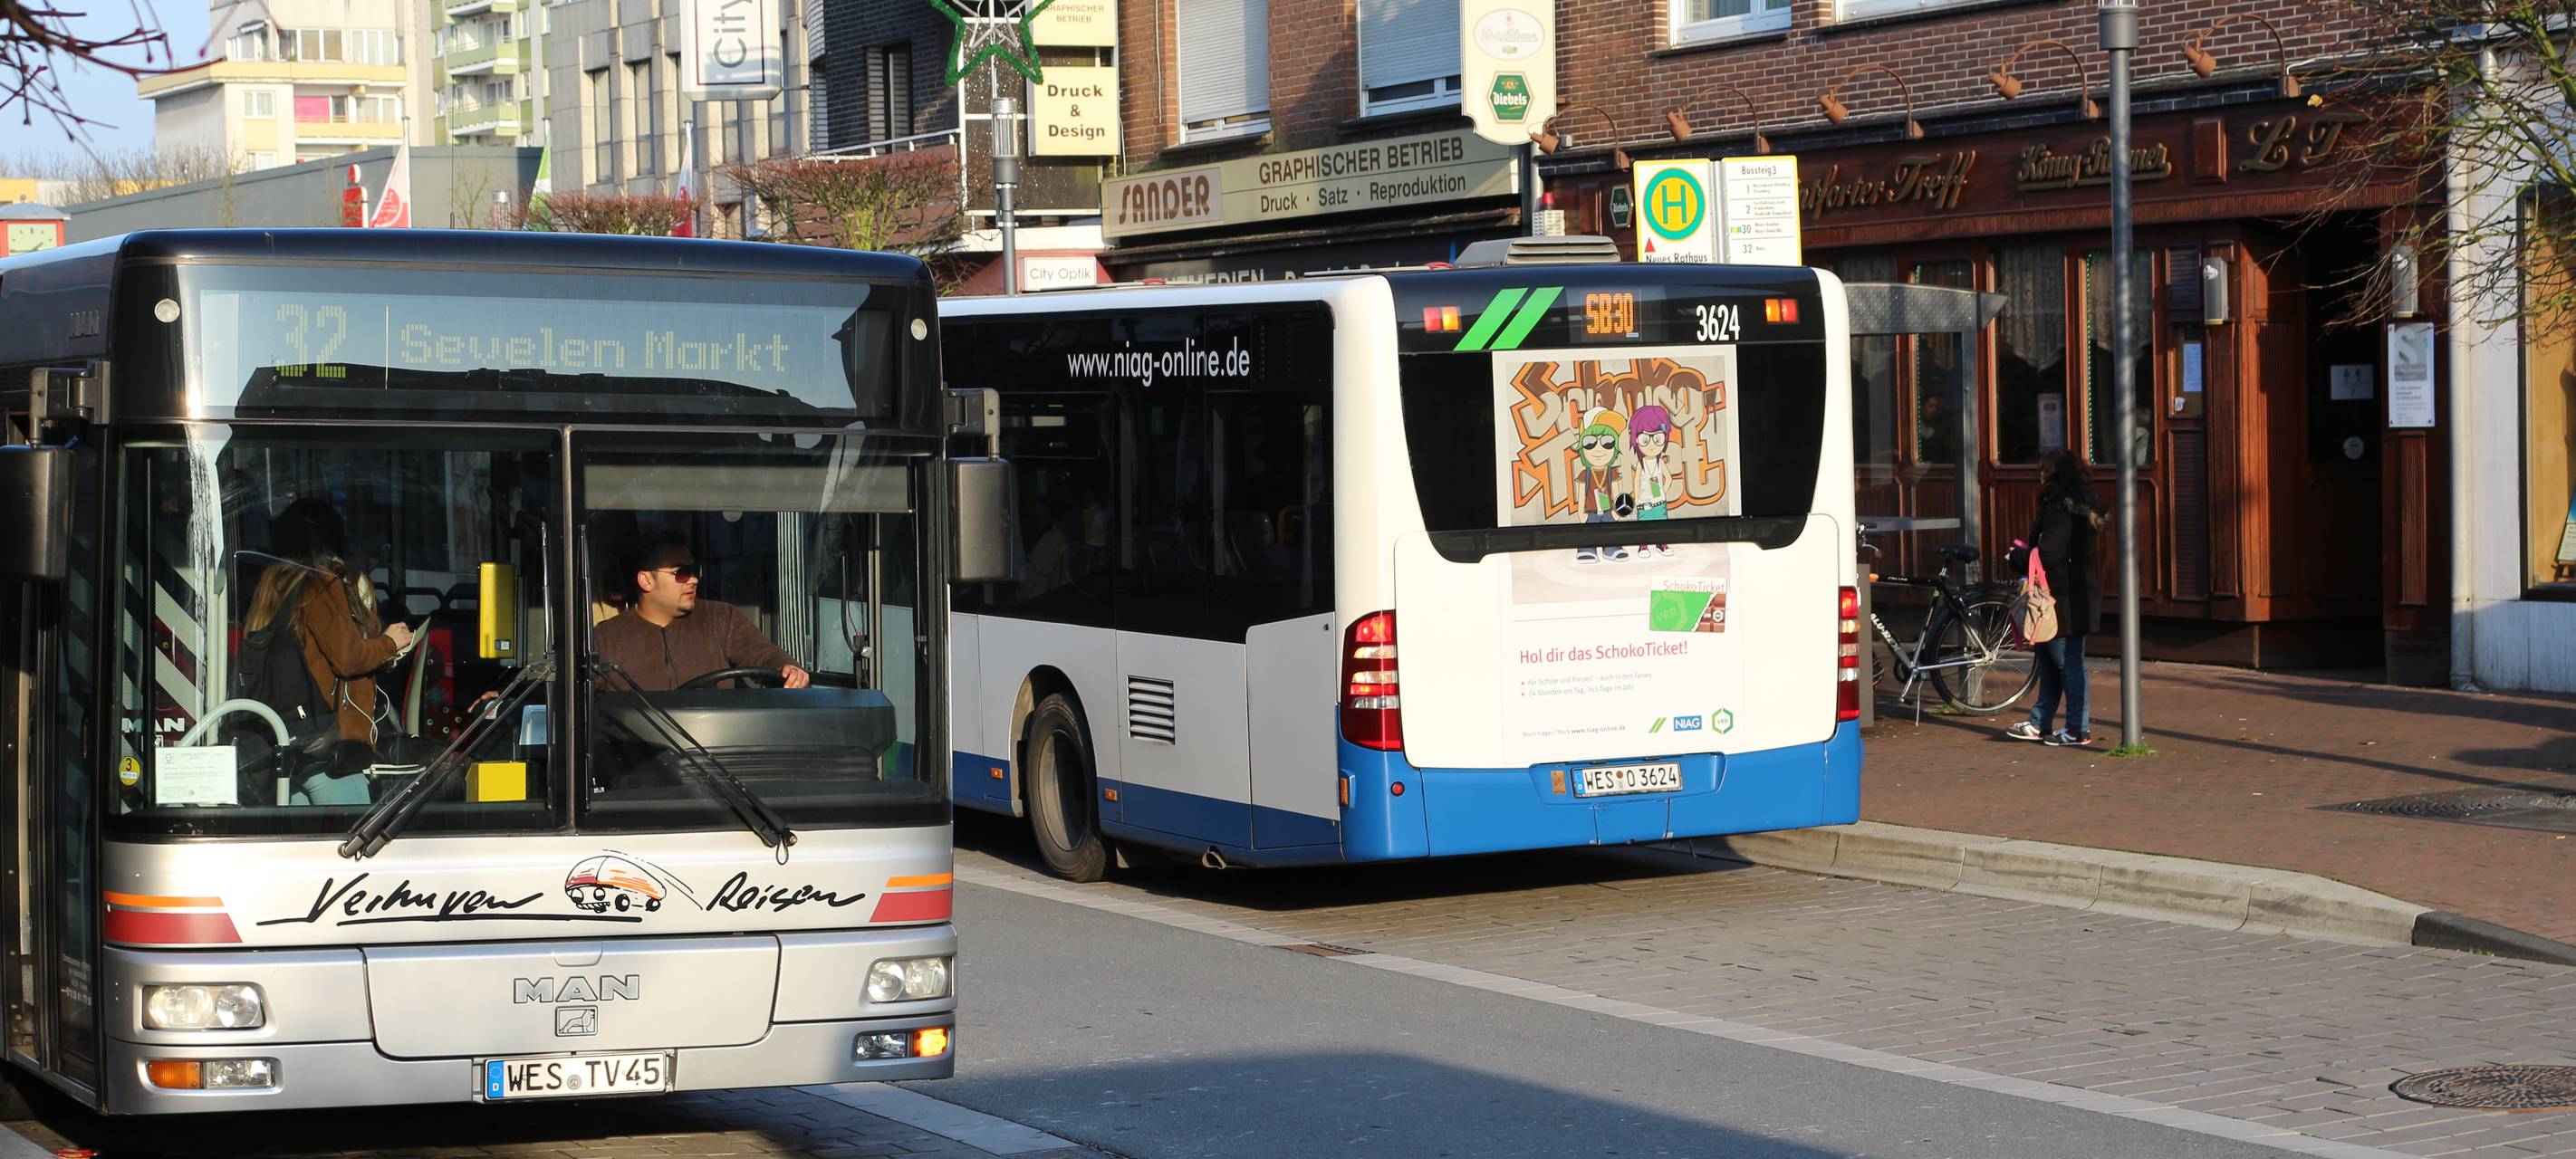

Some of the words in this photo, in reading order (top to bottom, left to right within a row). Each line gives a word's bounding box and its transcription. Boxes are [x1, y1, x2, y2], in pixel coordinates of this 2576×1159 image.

[1056, 14, 1092, 23] BETRIEB
[1047, 84, 1103, 97] Druck
[1493, 91, 1527, 105] Diebels
[1070, 104, 1081, 117] &
[1049, 125, 1105, 140] Design
[1259, 147, 1380, 185] GRAPHISCHER
[1388, 137, 1464, 168] BETRIEB
[1741, 166, 1772, 176] Bussteig
[1772, 166, 1777, 175] 3
[1888, 150, 1976, 209] Treff
[1119, 175, 1210, 225] SANDER
[1261, 192, 1298, 213] Druck
[1318, 187, 1348, 206] Satz
[1370, 175, 1466, 201] Reproduktion
[1661, 185, 1687, 224] H
[1646, 254, 1671, 263] Neues
[1674, 252, 1707, 263] Rathaus
[1743, 244, 1753, 254] 32
[1029, 267, 1055, 283] City
[1058, 267, 1091, 282] Optik
[1586, 292, 1634, 334] SB30
[1696, 304, 1740, 341] 3624
[276, 304, 348, 378] 32
[400, 323, 625, 369] Sevelen
[646, 330, 789, 373] Markt
[1067, 336, 1250, 387] www.niag-online.de
[1663, 580, 1725, 594] SchokoTicket
[1519, 647, 1543, 664] Hol
[1546, 647, 1565, 662] dir
[1569, 646, 1592, 661] das
[1596, 640, 1688, 660] SchokoTicket!
[1675, 717, 1701, 729] NIAG
[1585, 771, 1614, 790] WES
[1639, 768, 1677, 786] 3624
[705, 871, 865, 911] Reisen
[513, 973, 640, 1004] MAN
[492, 1082, 499, 1092] D
[507, 1063, 562, 1092] WES
